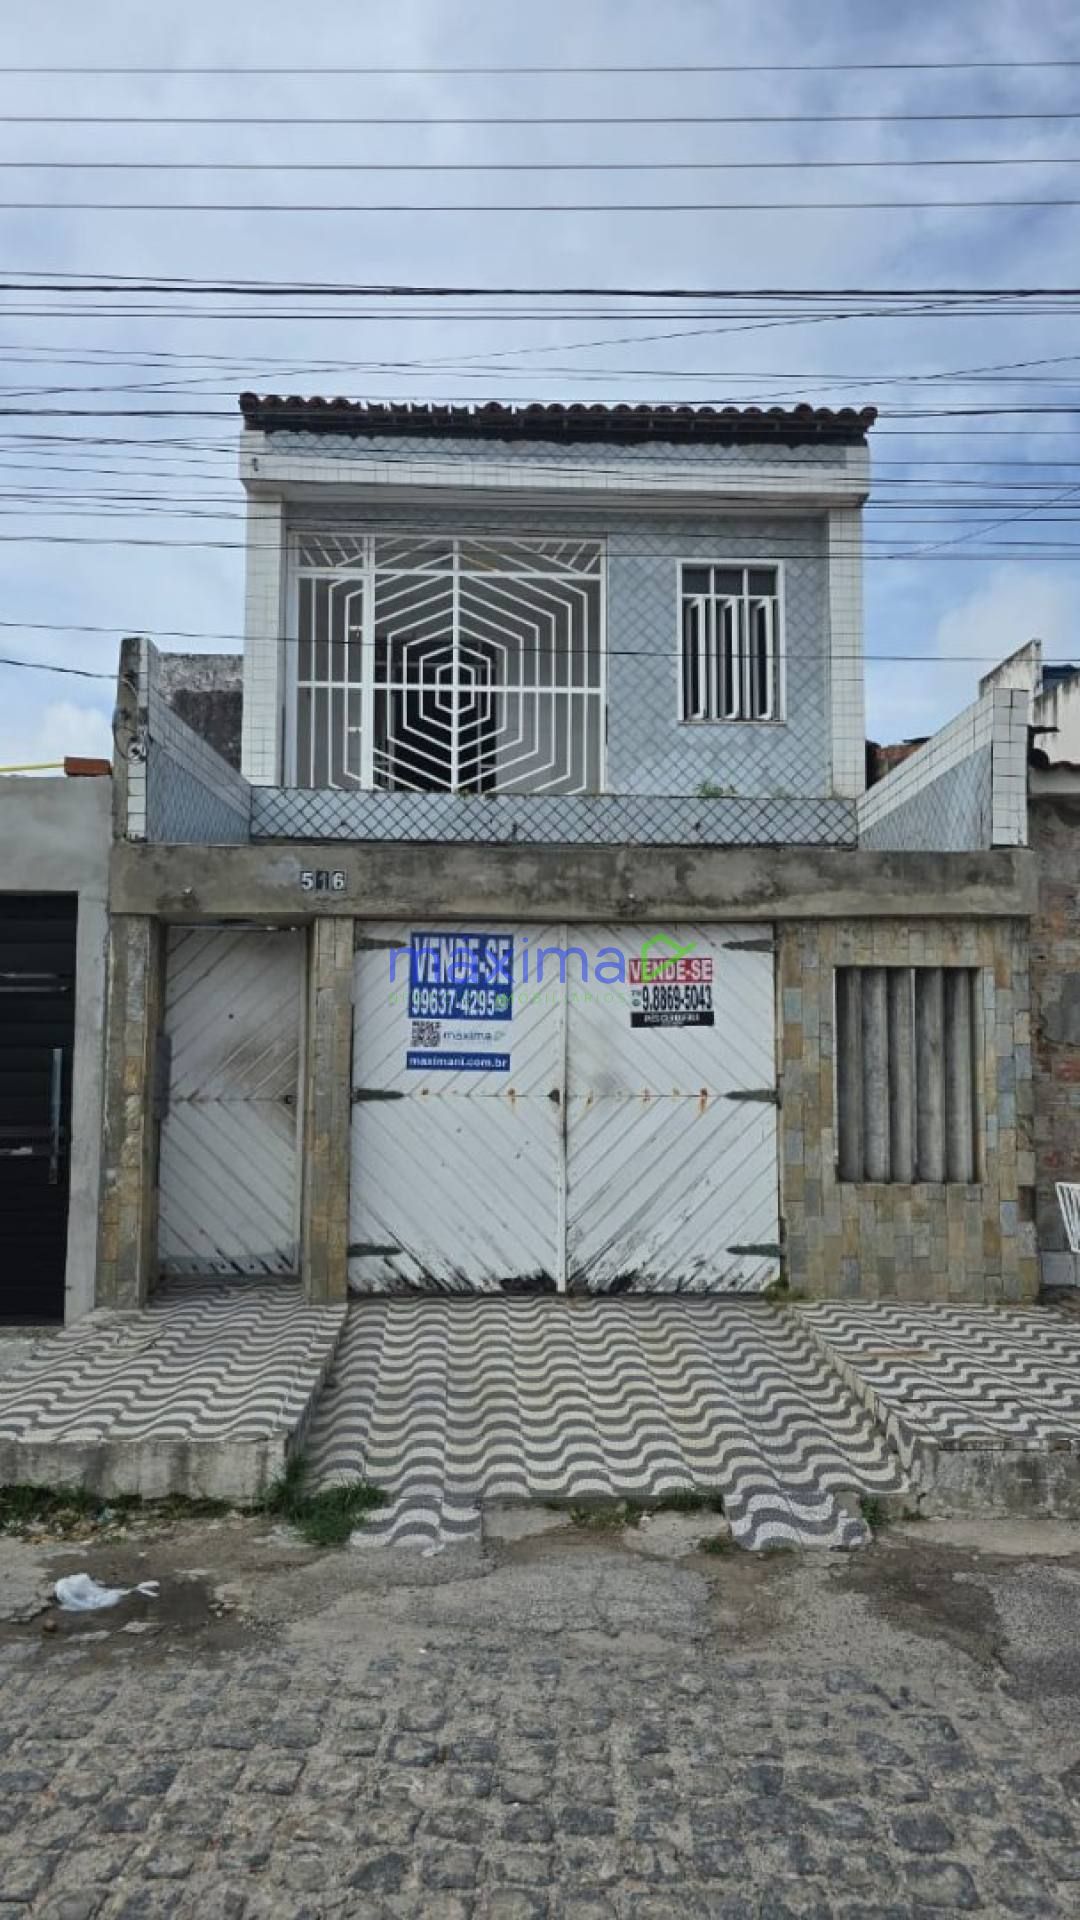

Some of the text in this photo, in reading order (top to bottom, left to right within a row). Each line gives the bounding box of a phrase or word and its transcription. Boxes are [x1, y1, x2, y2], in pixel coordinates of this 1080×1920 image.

[301, 871, 345, 890] 516
[413, 937, 510, 984] VENDE-SE
[630, 959, 713, 981] VENDE-SE
[411, 987, 495, 1016] 99637-4295
[642, 985, 712, 1010] 9.8869-5043
